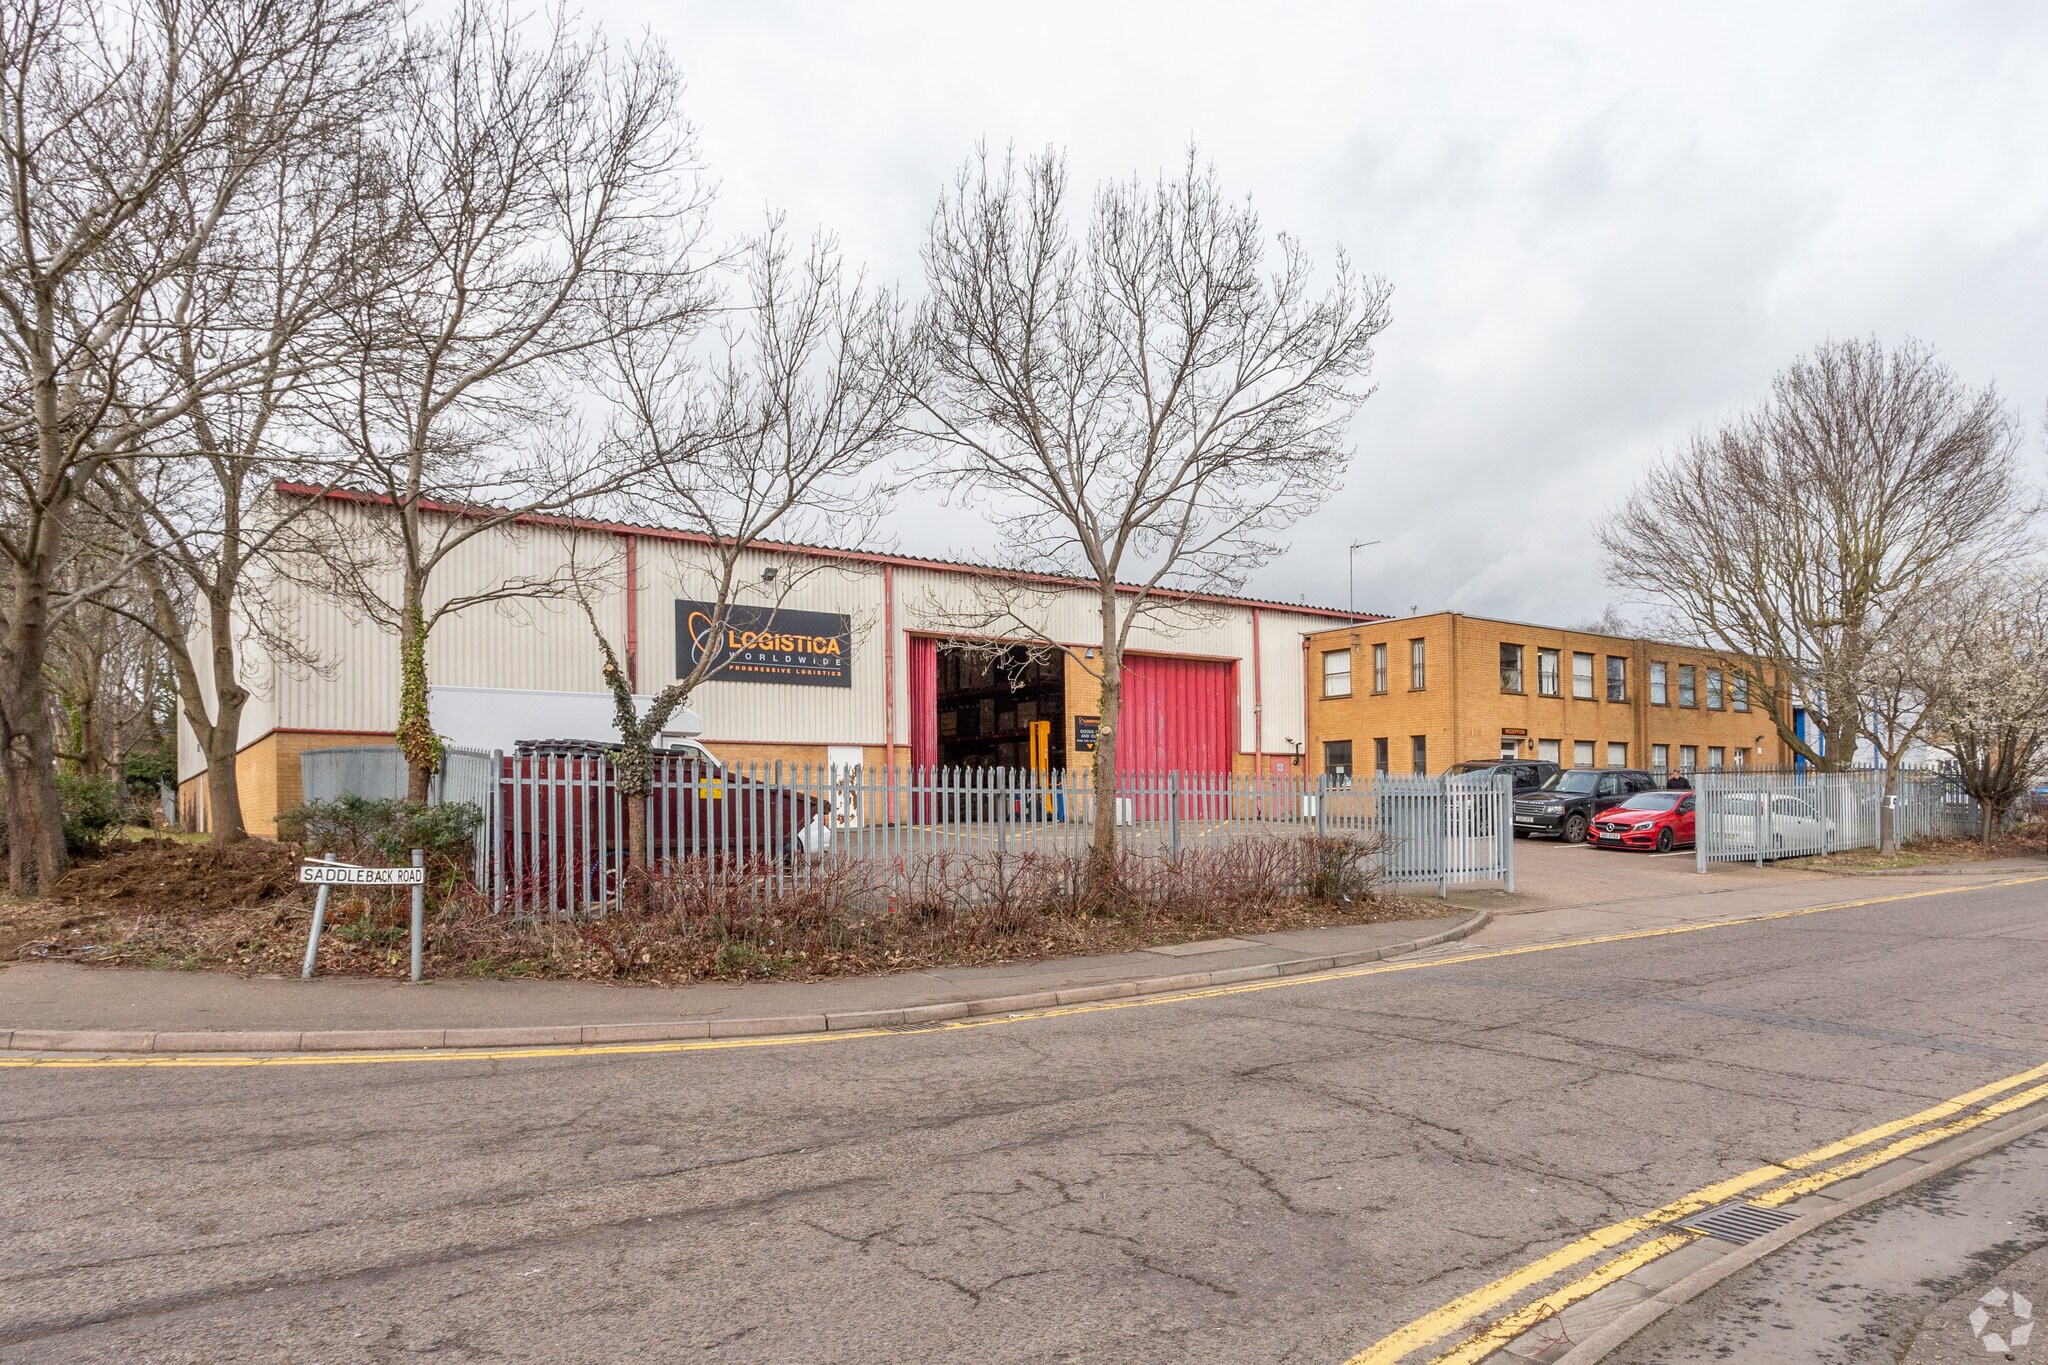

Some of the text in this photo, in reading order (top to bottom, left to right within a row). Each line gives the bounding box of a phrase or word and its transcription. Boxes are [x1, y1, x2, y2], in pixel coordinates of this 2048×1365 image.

[729, 630, 841, 655] LOGISTICA
[729, 651, 842, 666] WORLDWIDE
[729, 665, 842, 677] PROGRESSIVE LOGISTICS
[304, 868, 422, 883] SADDLEBACK ROAD
